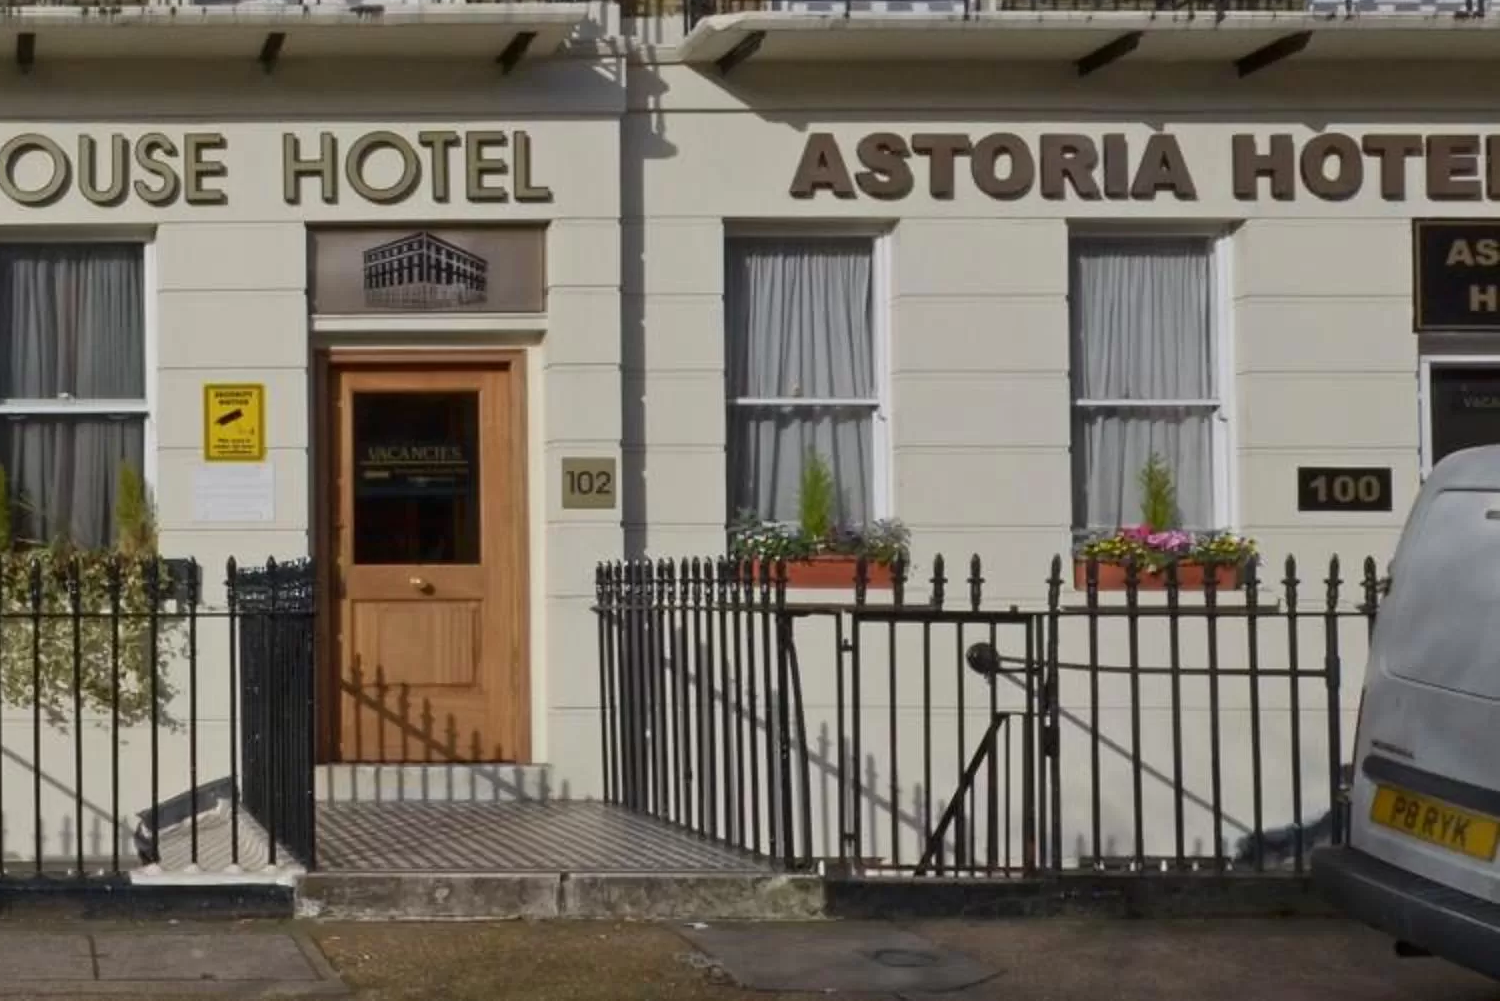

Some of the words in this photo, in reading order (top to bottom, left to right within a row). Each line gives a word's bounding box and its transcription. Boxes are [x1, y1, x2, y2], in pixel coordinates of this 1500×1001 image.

[283, 130, 554, 205] HOTEL
[788, 131, 1200, 201] ASTORIA
[367, 445, 462, 462] VACANCIES
[564, 470, 612, 496] 102
[1308, 474, 1381, 503] 100
